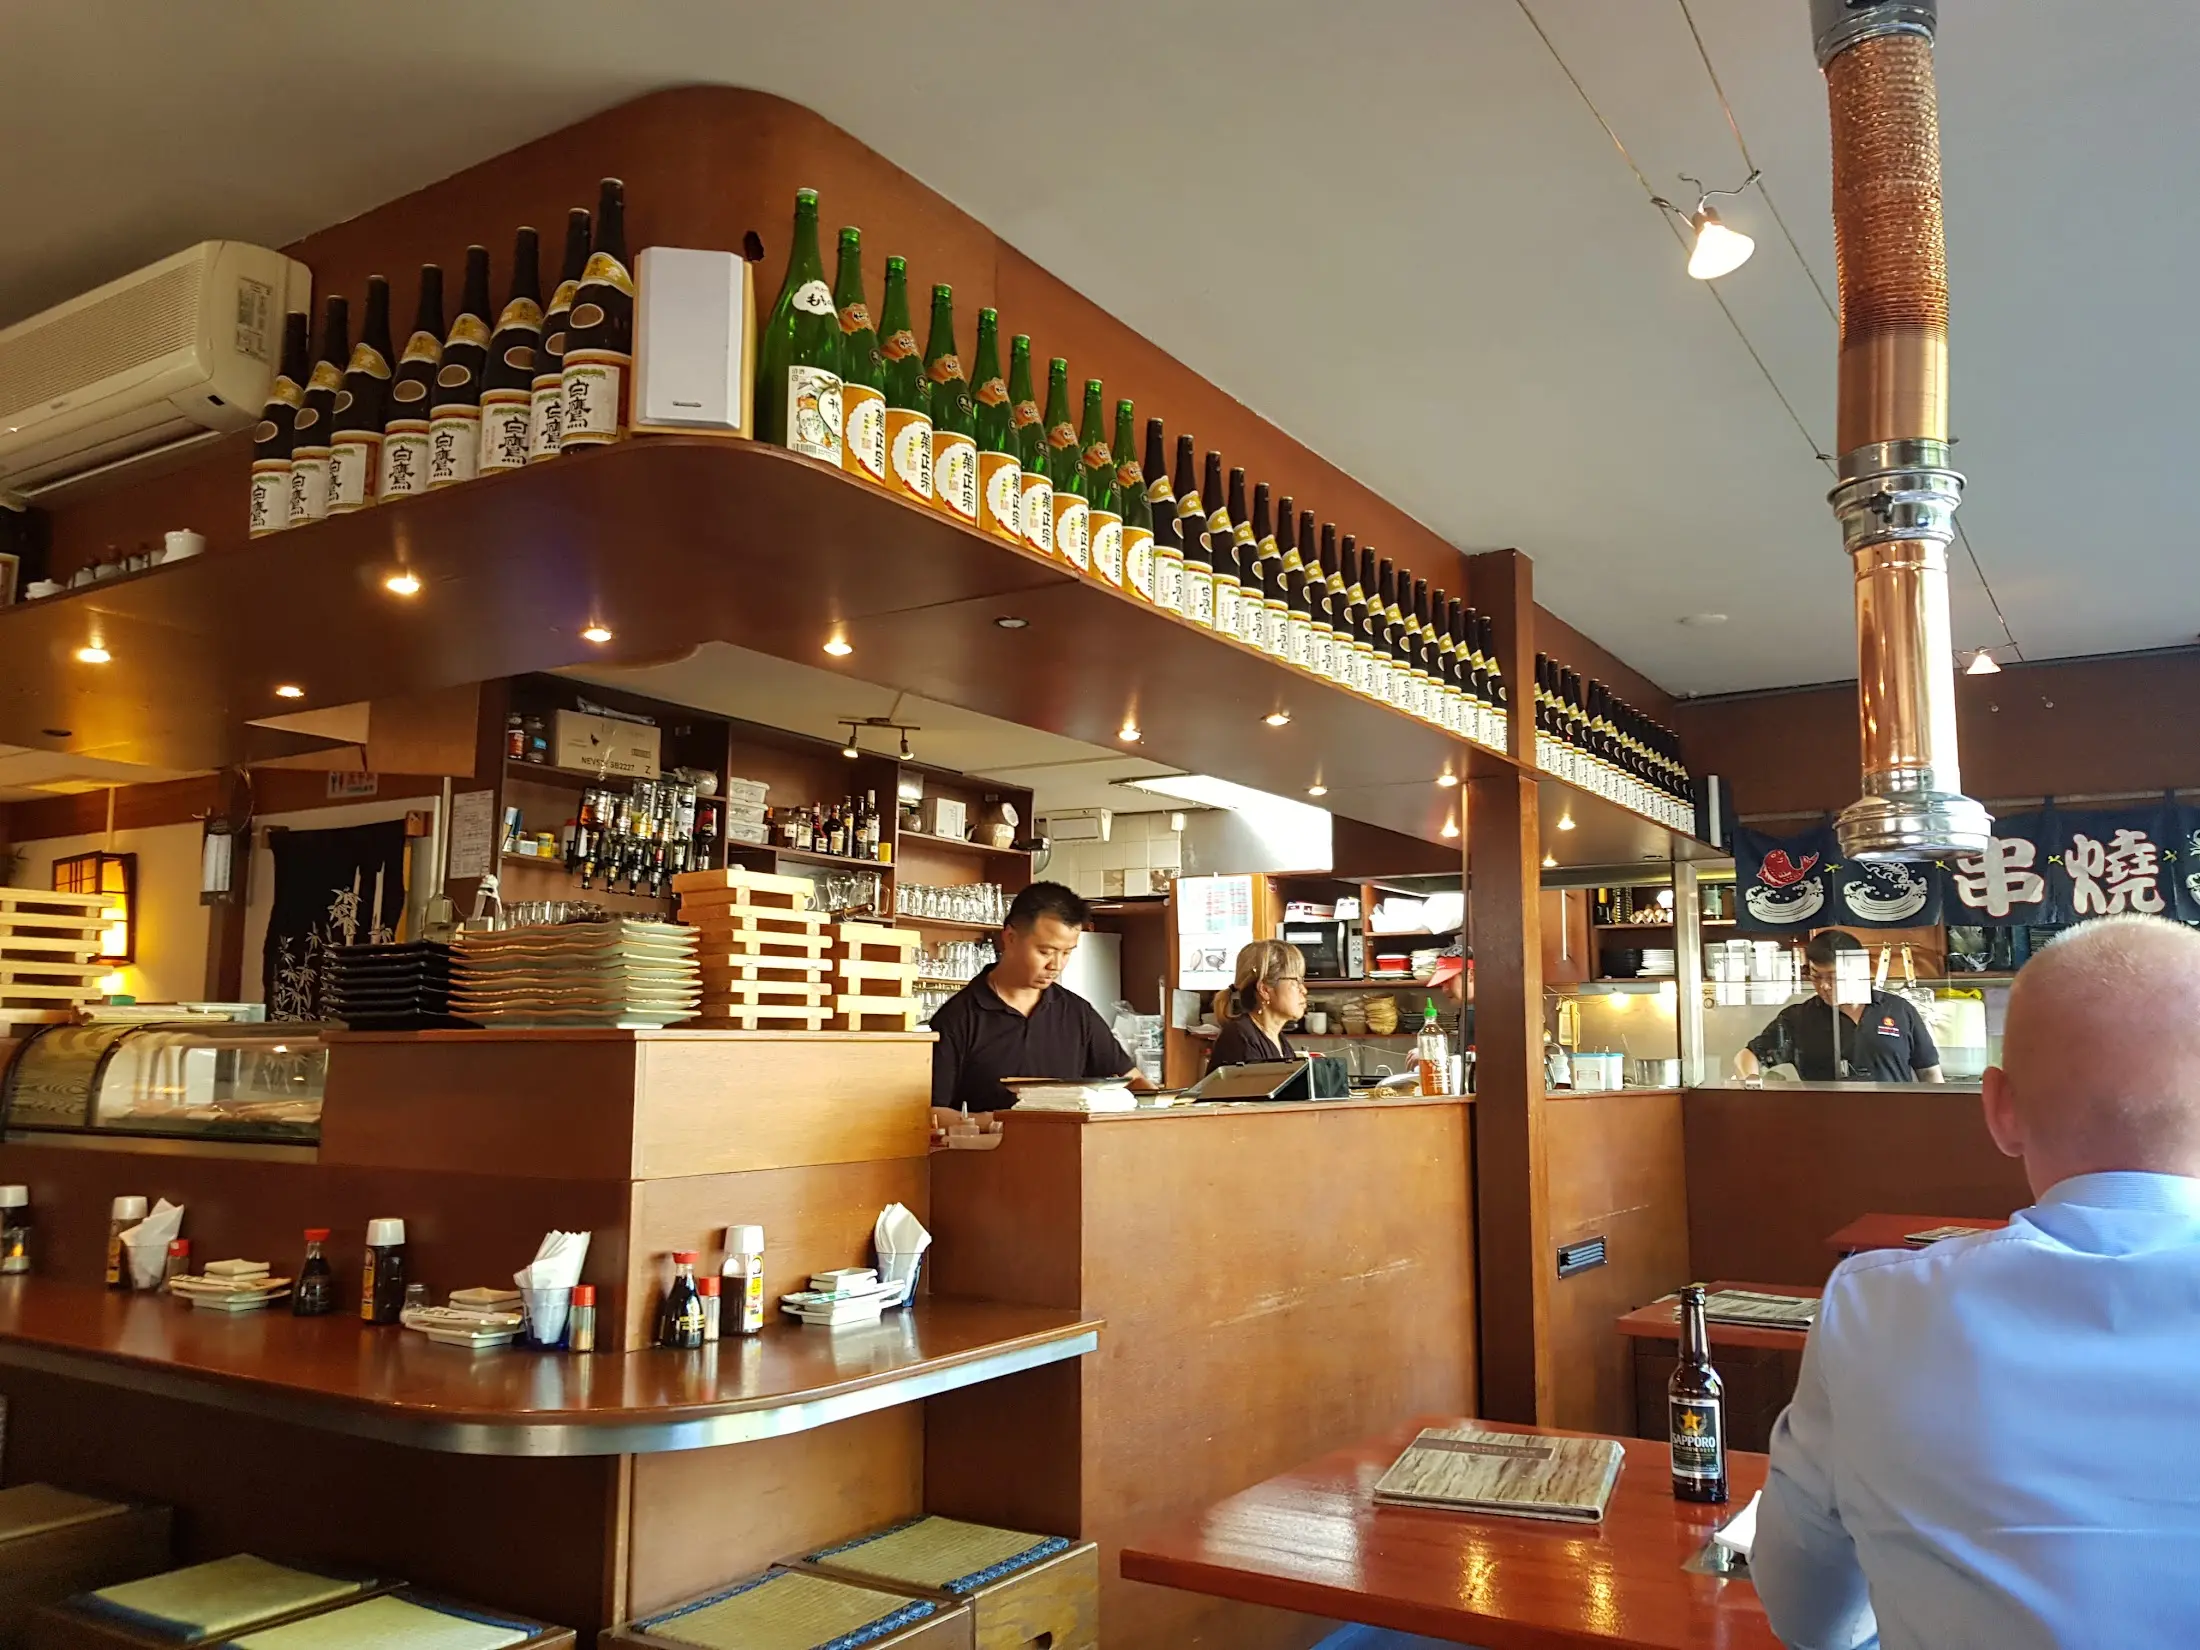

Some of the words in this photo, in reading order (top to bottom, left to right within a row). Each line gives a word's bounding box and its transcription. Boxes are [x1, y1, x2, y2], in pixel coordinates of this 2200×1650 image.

[565, 379, 592, 429] 白鷹
[431, 431, 456, 477] 白鷹
[498, 416, 529, 464] 白鷹
[388, 444, 415, 490] 白鷹
[1672, 1433, 1715, 1447] SAPPORO
